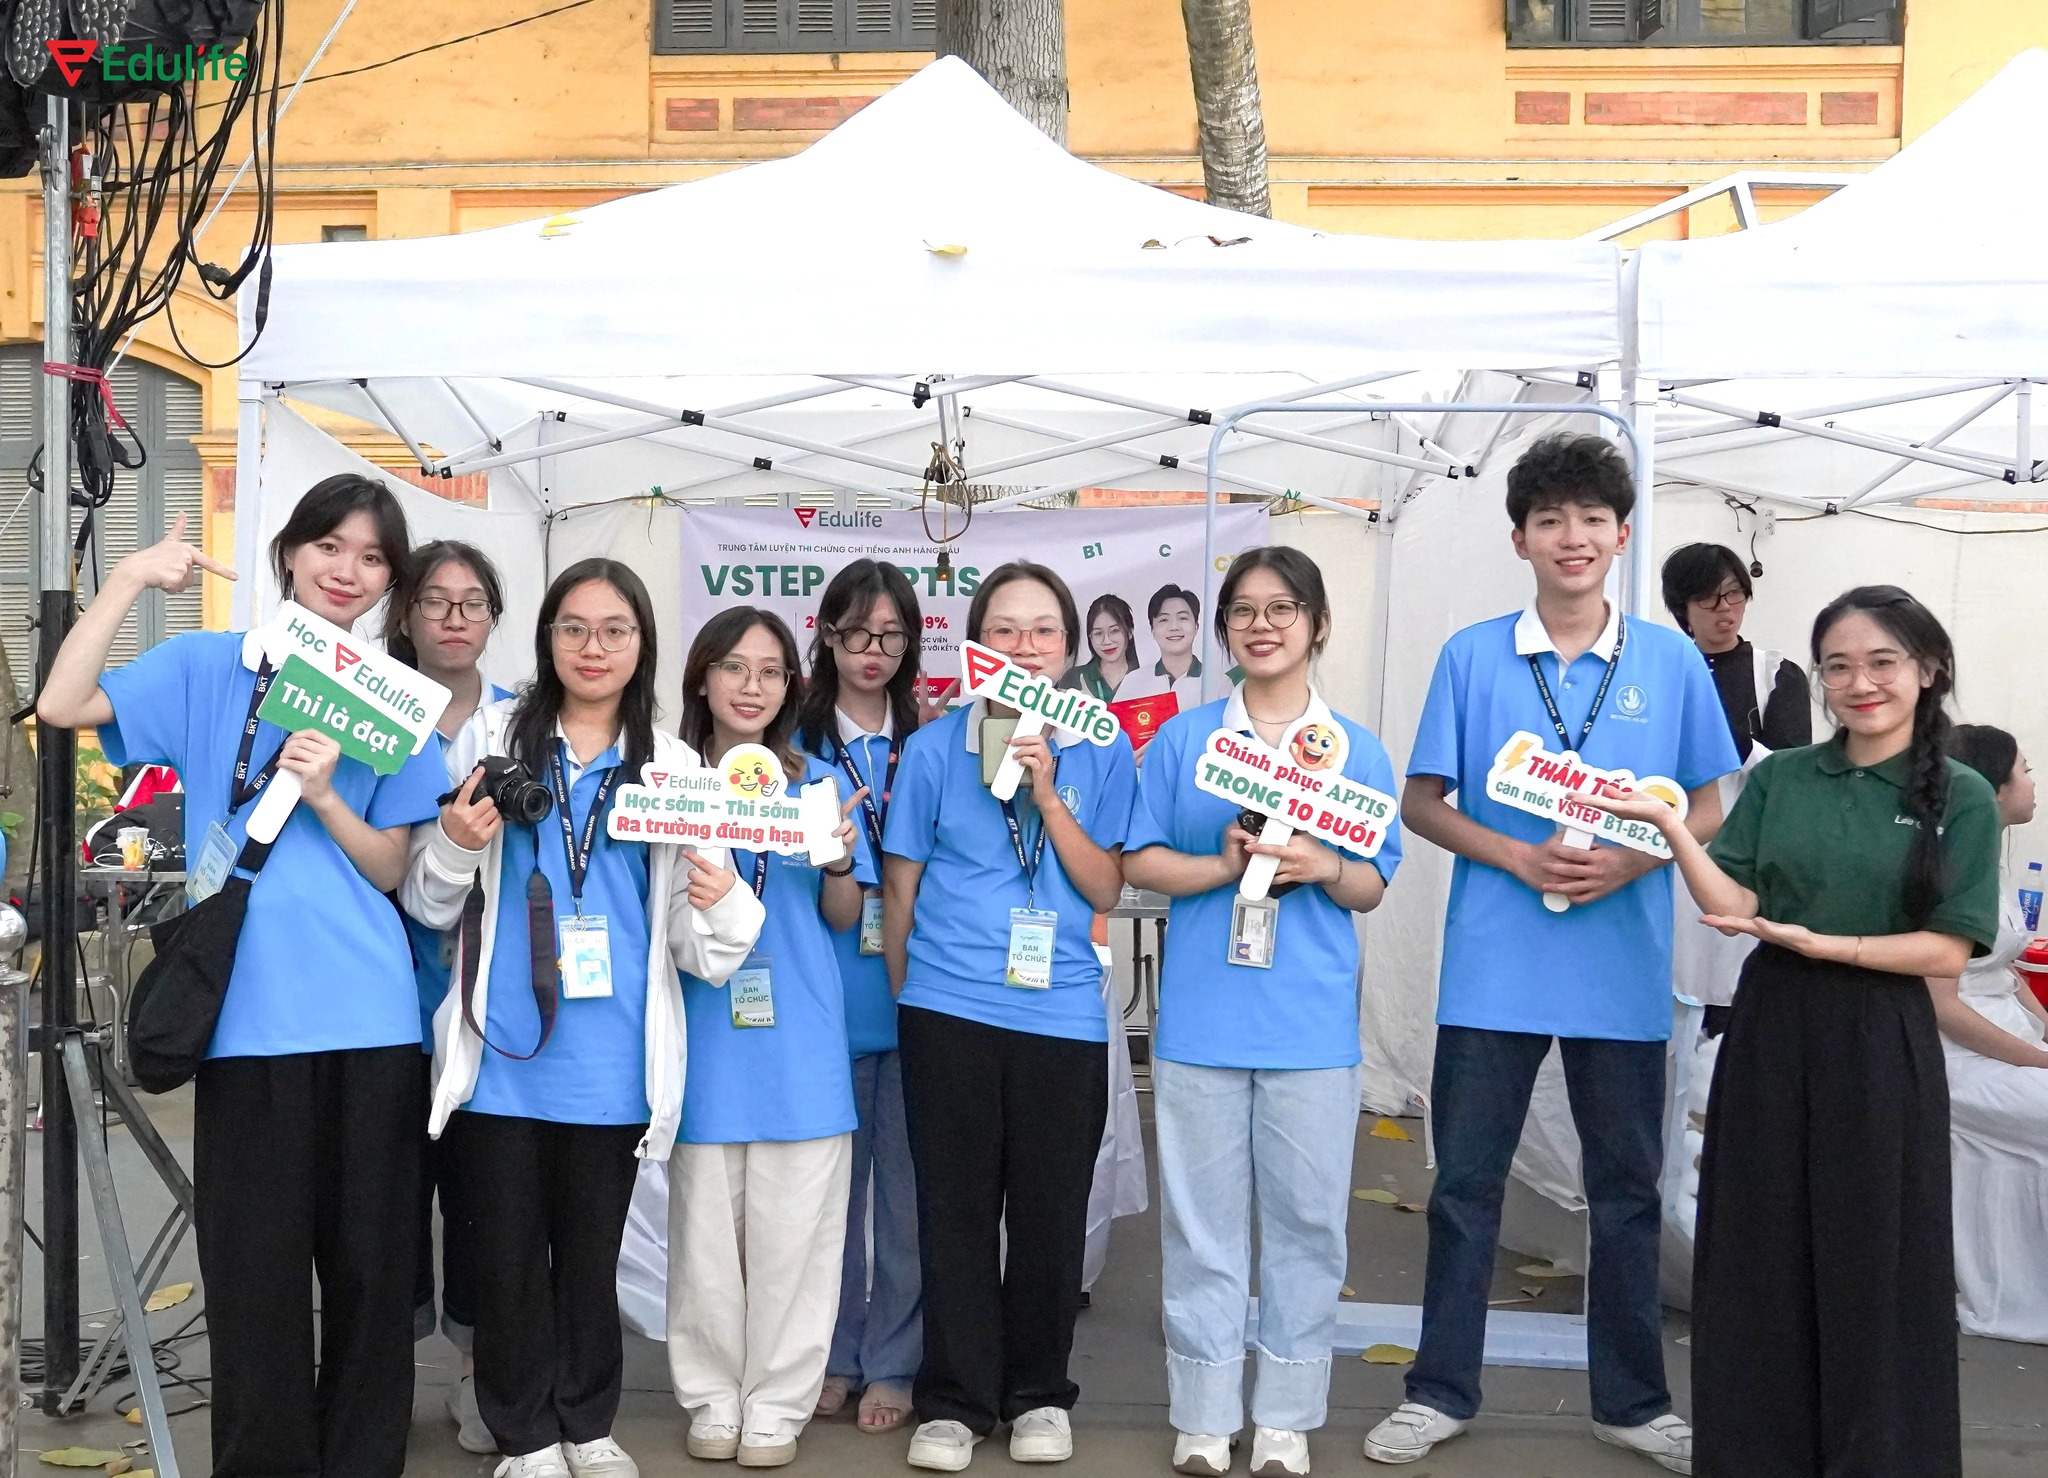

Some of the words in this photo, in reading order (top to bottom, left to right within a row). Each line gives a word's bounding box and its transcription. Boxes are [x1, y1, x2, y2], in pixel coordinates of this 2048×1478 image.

[818, 511, 883, 527] Edulife
[718, 543, 747, 552] TRUNG
[749, 542, 767, 552] TÂM
[769, 543, 796, 554] LUYỆN
[813, 544, 846, 553] CHỨNG
[847, 545, 864, 553] CHỈ
[866, 544, 891, 554] TIẾNG
[913, 545, 939, 554] HÀNG
[1082, 542, 1104, 559] B1
[1214, 555, 1238, 572] C
[700, 564, 825, 597] VSTEP
[897, 566, 981, 597] PTIS
[920, 615, 949, 630] 9%
[286, 617, 327, 653] Học
[353, 663, 426, 723] Edulife
[258, 675, 269, 693] BKT
[997, 669, 1114, 741] Edulife
[247, 717, 258, 735] BKT
[281, 681, 324, 718] Thi
[322, 702, 350, 732] là
[352, 719, 399, 756] đạt
[237, 761, 248, 780] BKT
[1215, 737, 1272, 772] Chinh
[1273, 764, 1323, 793] phục
[1325, 784, 1388, 819] APTIS
[1527, 755, 1588, 791] THẦN
[253, 772, 269, 790] BKT
[669, 775, 722, 791] Edulife
[624, 793, 661, 813] Học
[665, 794, 705, 813] sớm
[725, 800, 754, 817] Thi
[759, 802, 800, 820] sớm
[1204, 762, 1283, 810] TRONG
[1286, 798, 1313, 822] 10
[1316, 810, 1377, 848] BUỔI
[1495, 781, 1520, 799] cán
[1522, 791, 1554, 810] mốc
[1558, 798, 1602, 825] VSTEP
[616, 816, 641, 832] Ra
[646, 817, 711, 840] trường
[715, 822, 764, 843] đúng
[769, 825, 804, 847] hạn
[1022, 944, 1039, 952] BAN
[743, 986, 759, 994] BAN
